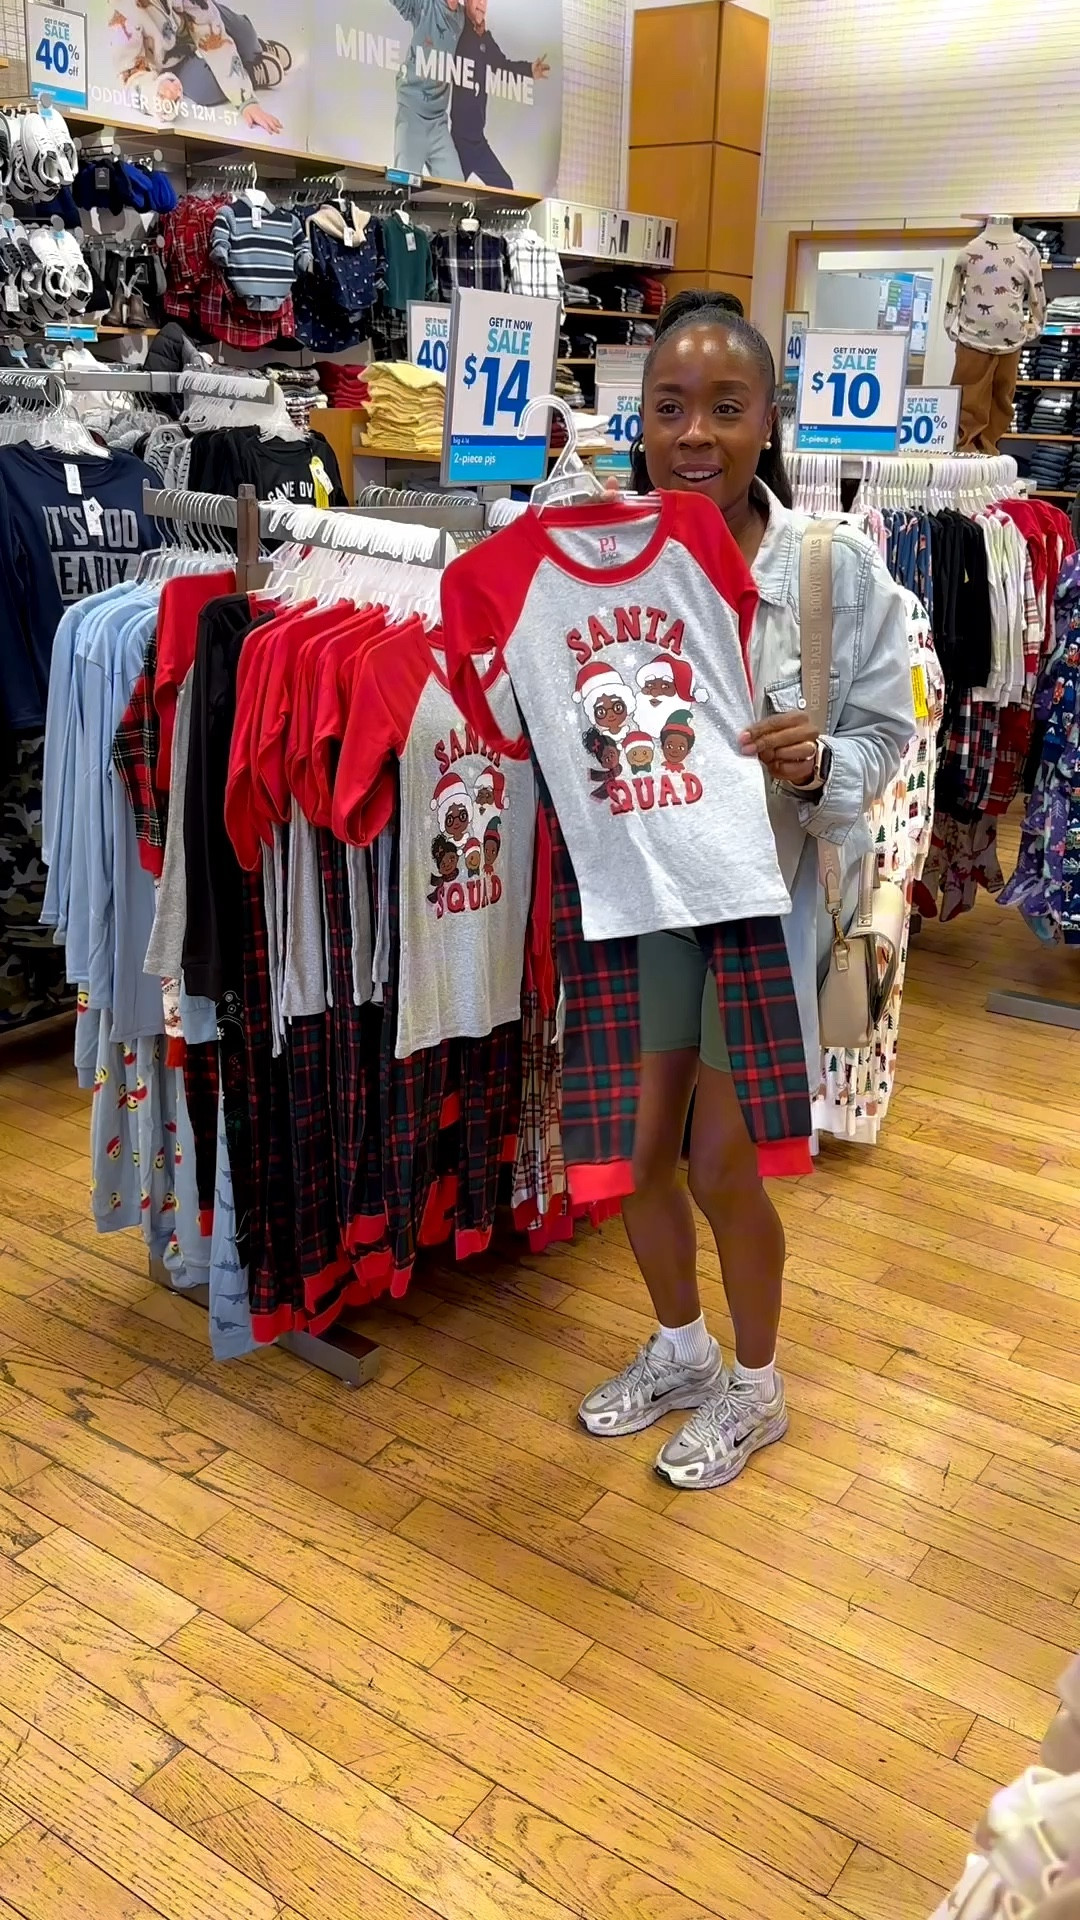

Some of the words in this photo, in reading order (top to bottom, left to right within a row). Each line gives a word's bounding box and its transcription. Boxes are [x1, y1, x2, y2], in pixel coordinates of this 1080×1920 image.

[44, 24, 69, 40] SALE
[68, 66, 79, 76] off
[335, 23, 408, 79] MINE,
[415, 46, 480, 97] MINE,
[485, 64, 534, 105] MINE
[89, 84, 150, 111] ODDLER
[153, 96, 189, 118] BOYS
[425, 323, 448, 337] SALE
[489, 316, 504, 328] GET
[505, 318, 512, 328] IT
[514, 319, 533, 331] NOW
[486, 328, 531, 355] SALE
[849, 347, 856, 355] IT
[857, 347, 878, 355] NOW
[831, 354, 877, 370] SALE
[463, 353, 531, 428] $14
[811, 371, 881, 418] $10
[907, 402, 938, 414] SALE
[452, 436, 461, 445] big
[800, 434, 829, 444] 2-piece
[830, 435, 842, 445] pjs
[931, 435, 944, 445] off
[454, 452, 483, 466] 2-piece
[484, 452, 496, 466] pjs
[42, 505, 89, 546] IT'S
[597, 535, 617, 554] PJ
[566, 606, 685, 665] SANTA
[810, 632, 822, 665] STEVE
[435, 874, 502, 919] SQUAD
